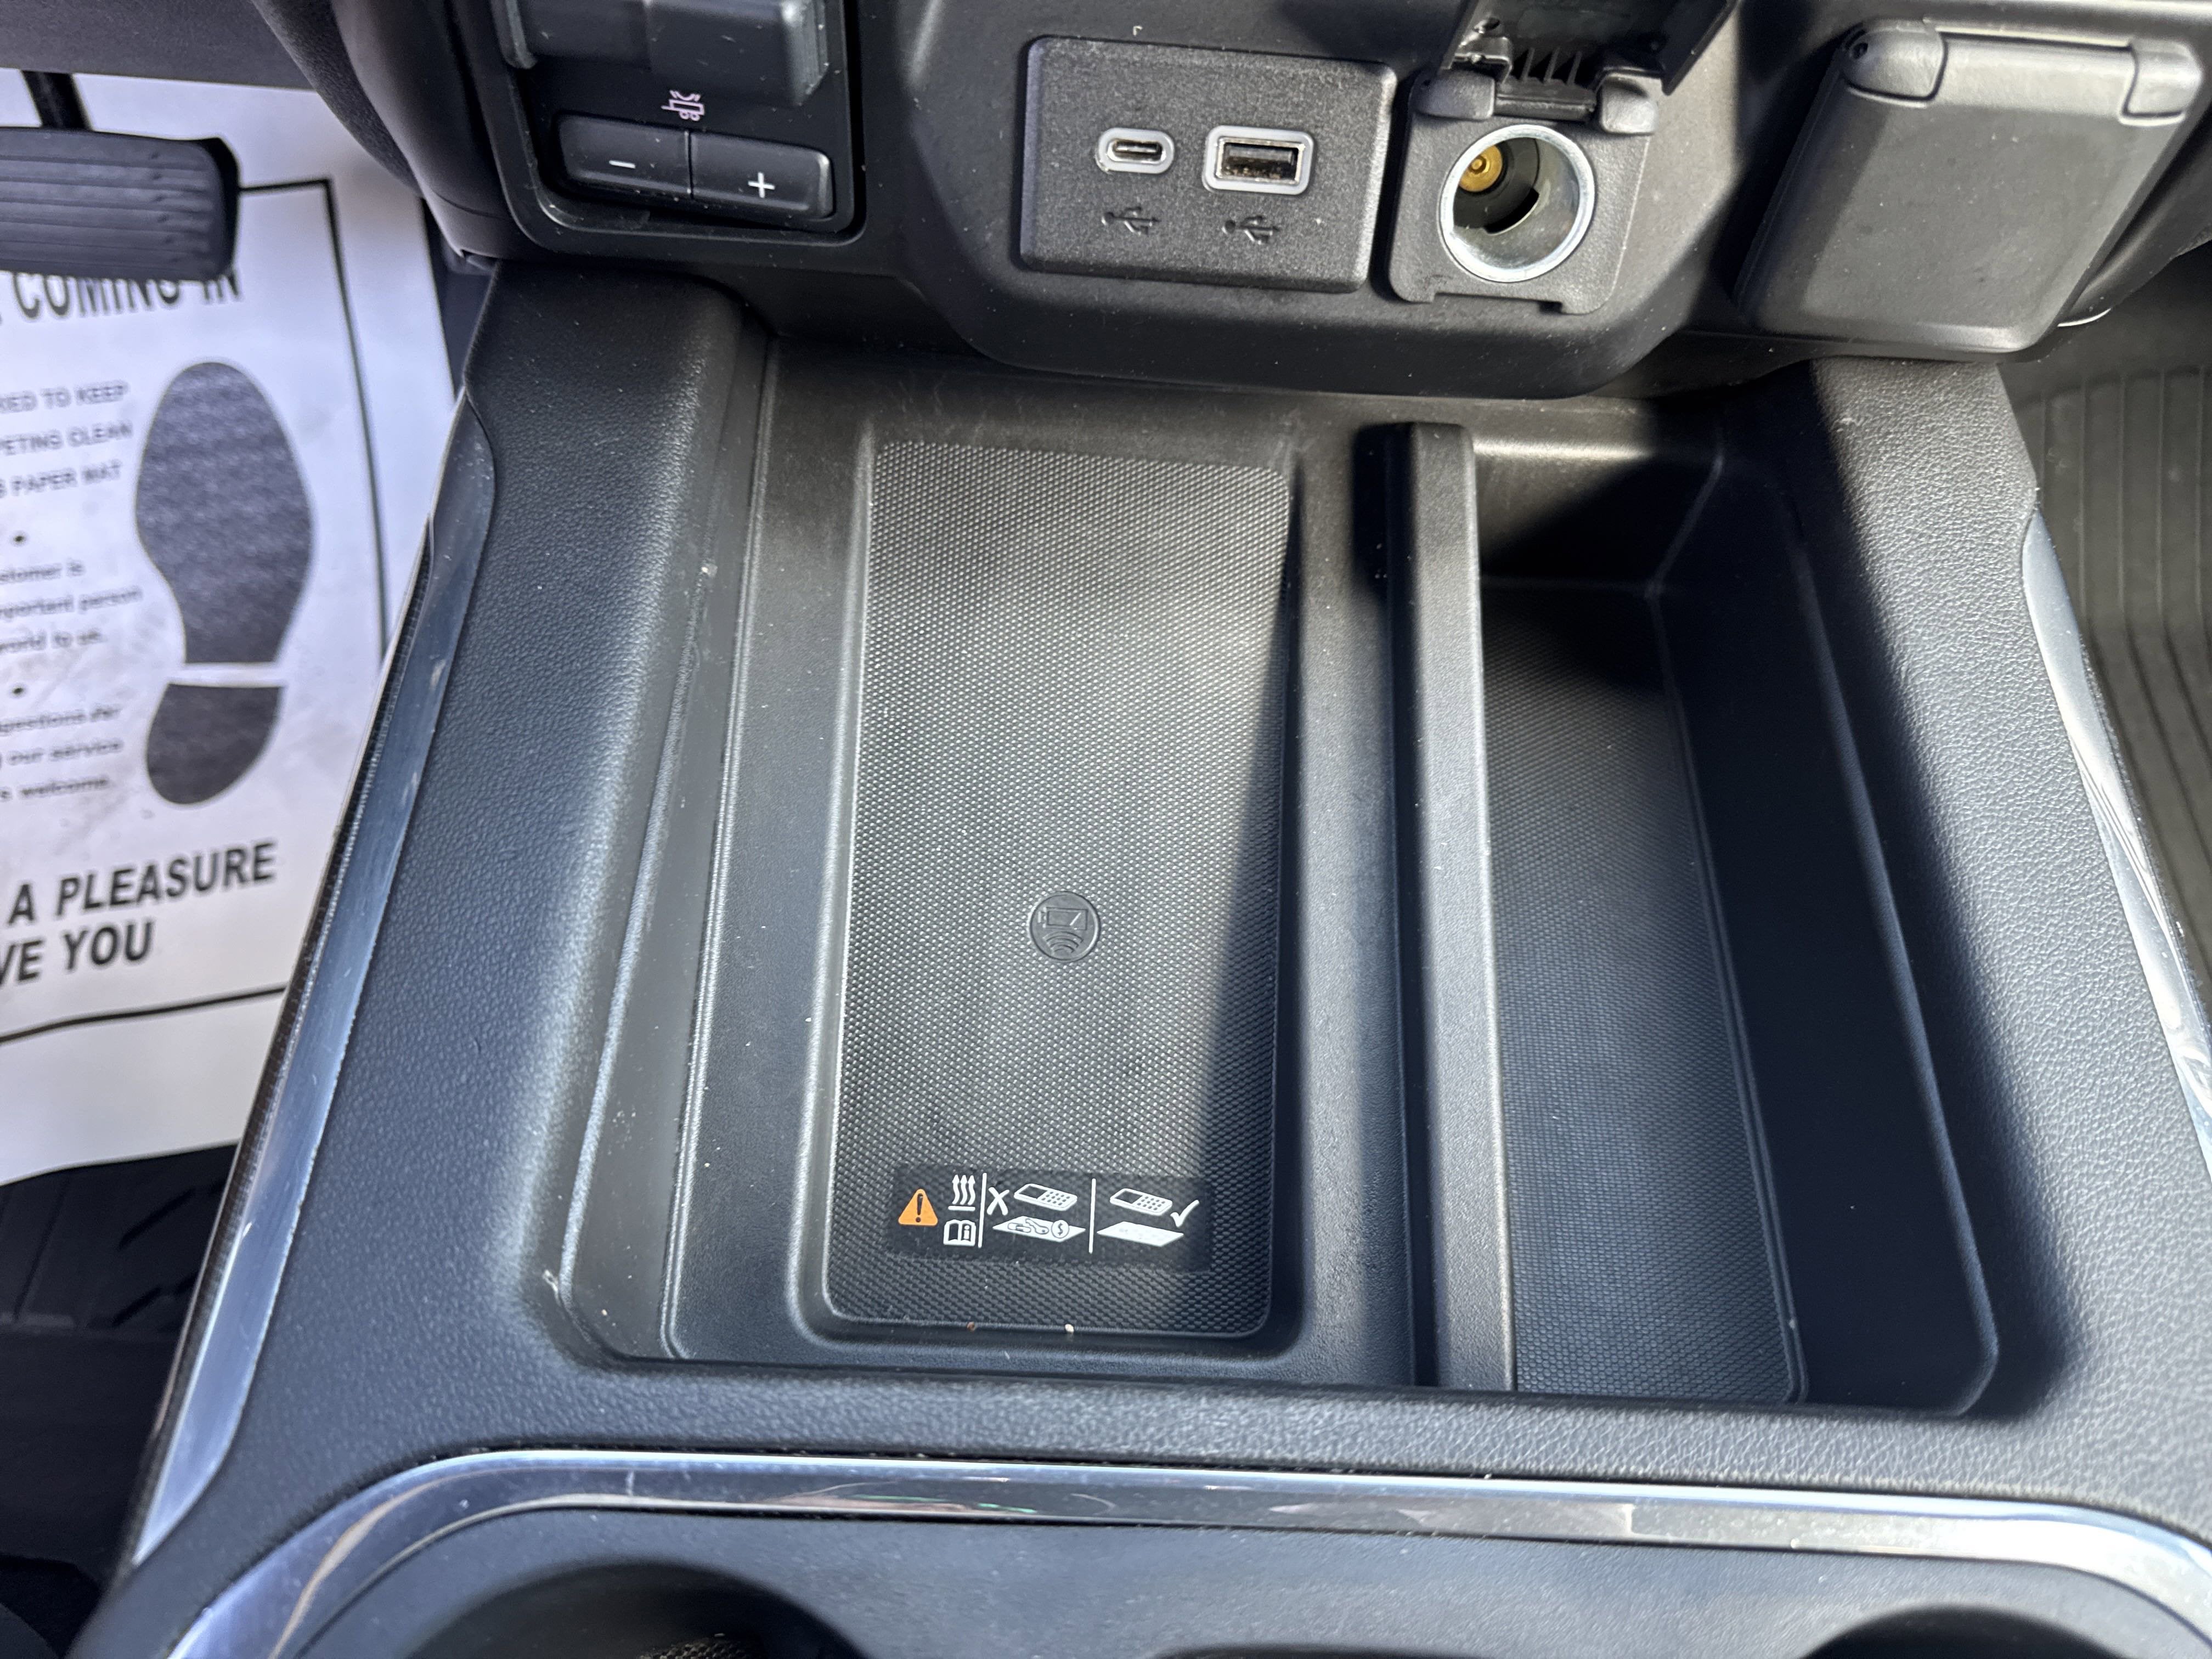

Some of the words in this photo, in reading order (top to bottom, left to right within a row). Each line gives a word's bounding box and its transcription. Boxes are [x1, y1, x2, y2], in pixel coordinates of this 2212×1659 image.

[41, 389, 70, 407] TO
[76, 382, 127, 403] KEEP
[69, 423, 132, 445] CLEAN
[12, 470, 76, 494] PAPER
[83, 462, 121, 483] MAT
[80, 588, 141, 613] person
[53, 631, 71, 647] to
[9, 749, 44, 764] our
[50, 740, 122, 759] service
[8, 883, 35, 926] A
[57, 842, 275, 916] PLEASURE
[63, 921, 154, 970] YOU
